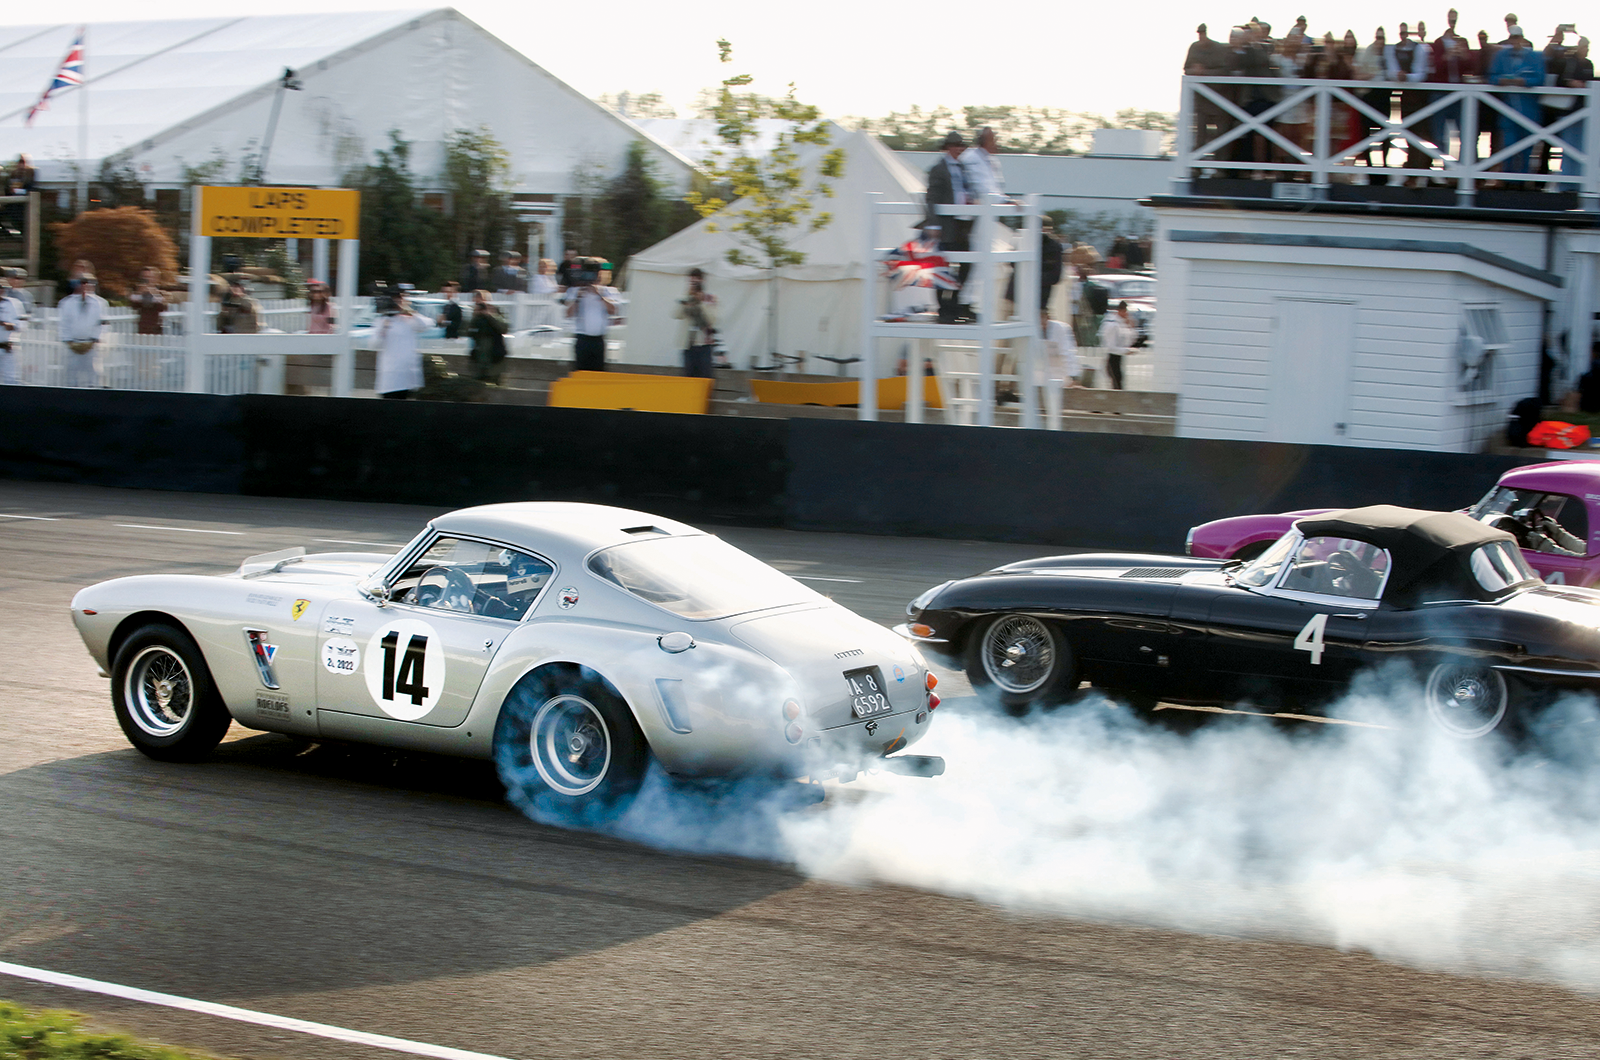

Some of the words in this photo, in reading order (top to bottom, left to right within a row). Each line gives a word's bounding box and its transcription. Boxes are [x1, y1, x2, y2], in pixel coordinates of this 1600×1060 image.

[249, 191, 308, 210] LAPS
[211, 215, 344, 236] COMPLETED
[1293, 613, 1329, 665] 4
[380, 630, 429, 706] 14
[865, 674, 878, 691] 8
[854, 693, 890, 715] 6592
